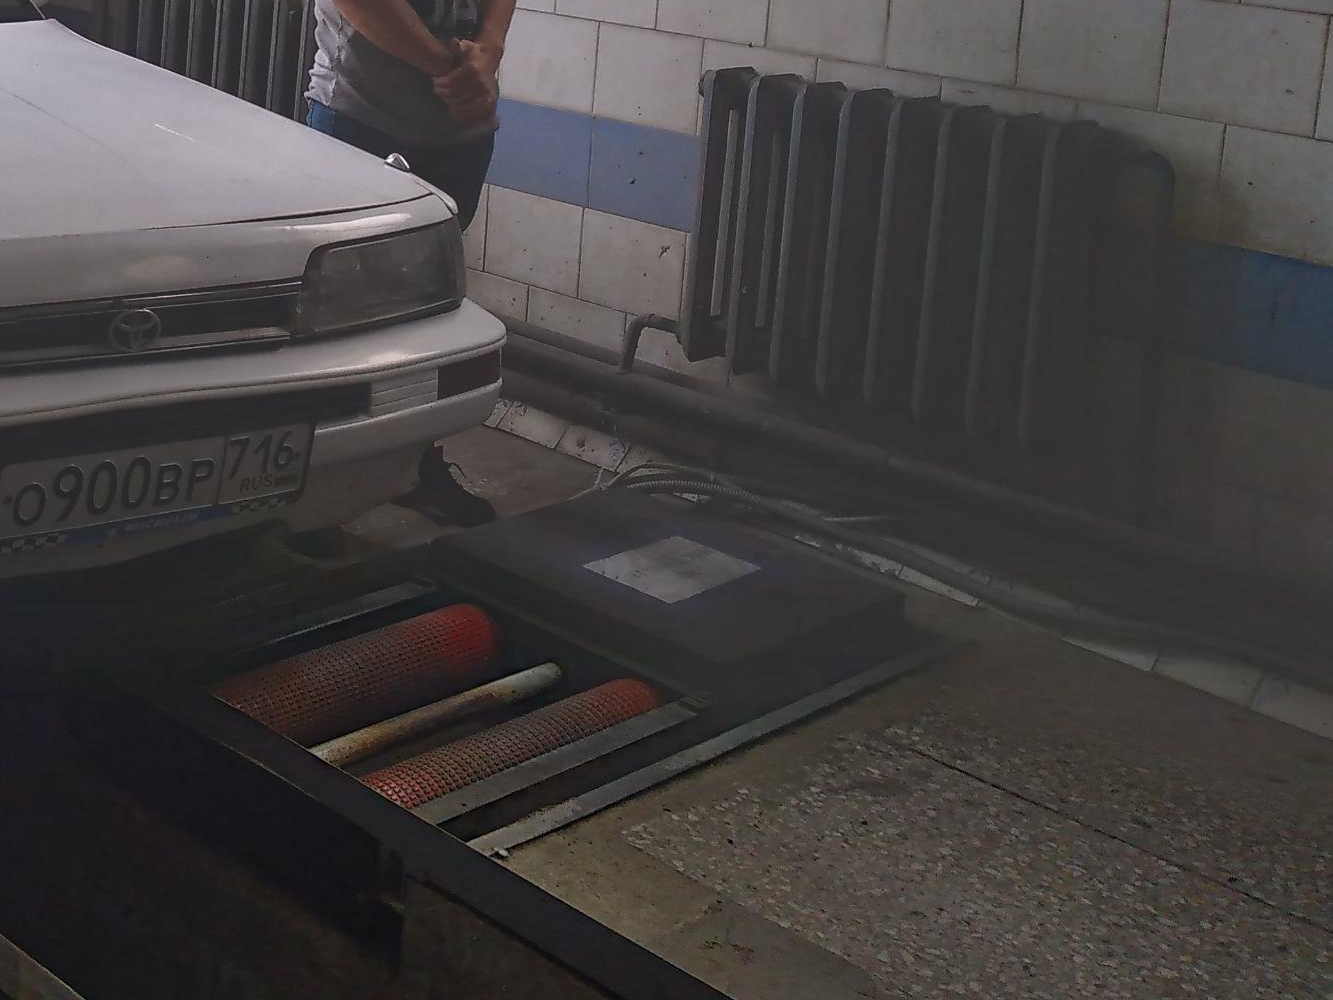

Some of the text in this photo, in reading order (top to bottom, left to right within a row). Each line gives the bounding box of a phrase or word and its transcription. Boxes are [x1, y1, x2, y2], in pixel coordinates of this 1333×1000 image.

[12, 431, 296, 527] О900ВР 716
[239, 473, 273, 493] RUS
